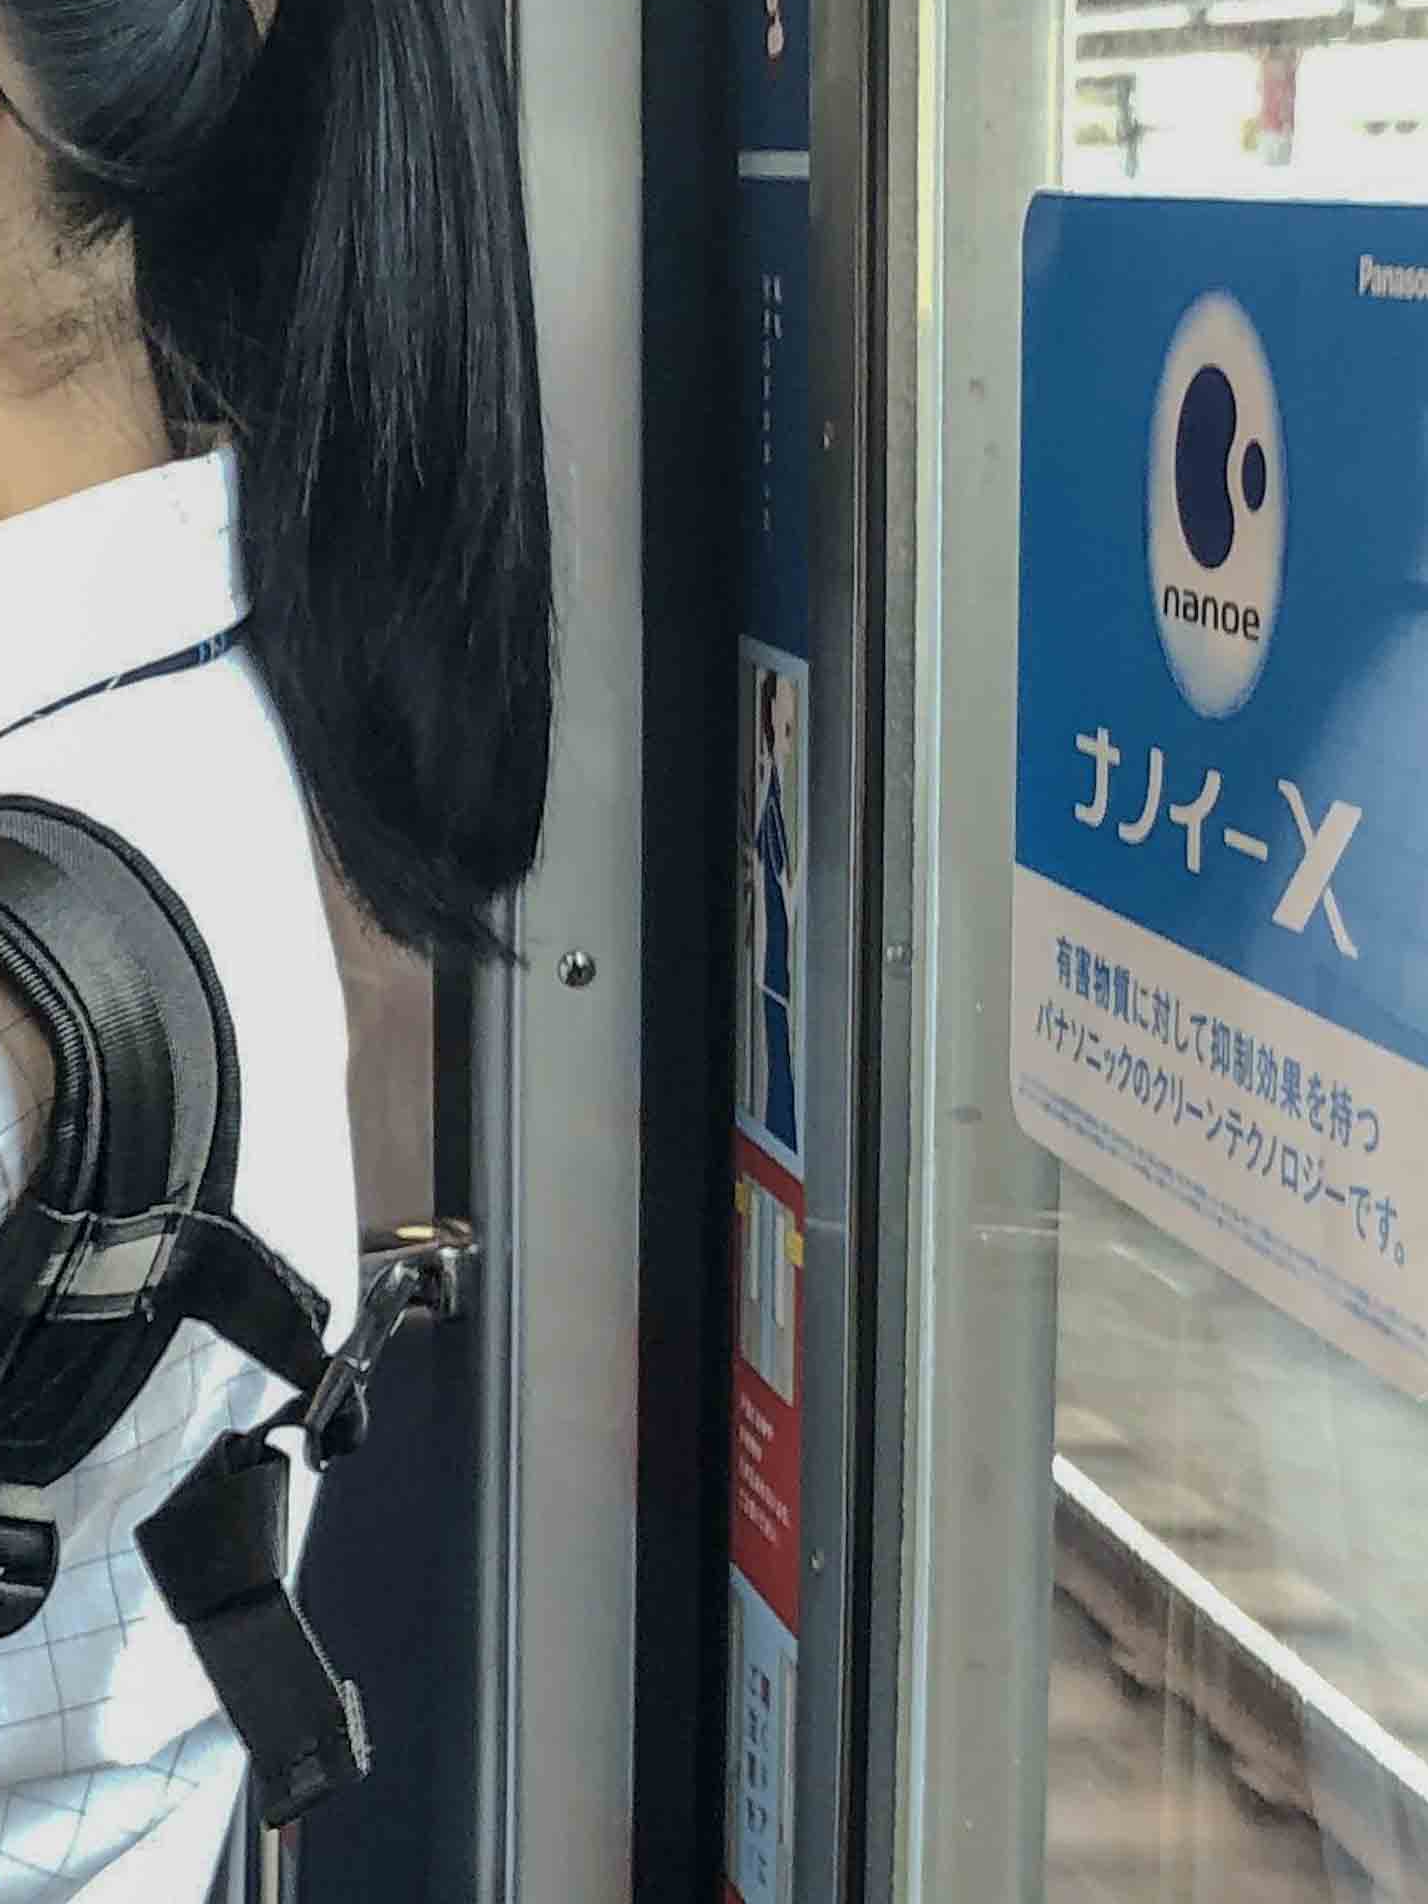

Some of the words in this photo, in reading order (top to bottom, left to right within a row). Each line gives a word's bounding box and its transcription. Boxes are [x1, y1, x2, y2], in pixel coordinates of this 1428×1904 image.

[1163, 584, 1261, 642] nanoe
[1035, 1000, 1407, 1267] パナソニックのクリーンテクノロジーです。
[1056, 934, 1381, 1154] 有害物質に対して抑制効果を持つ
